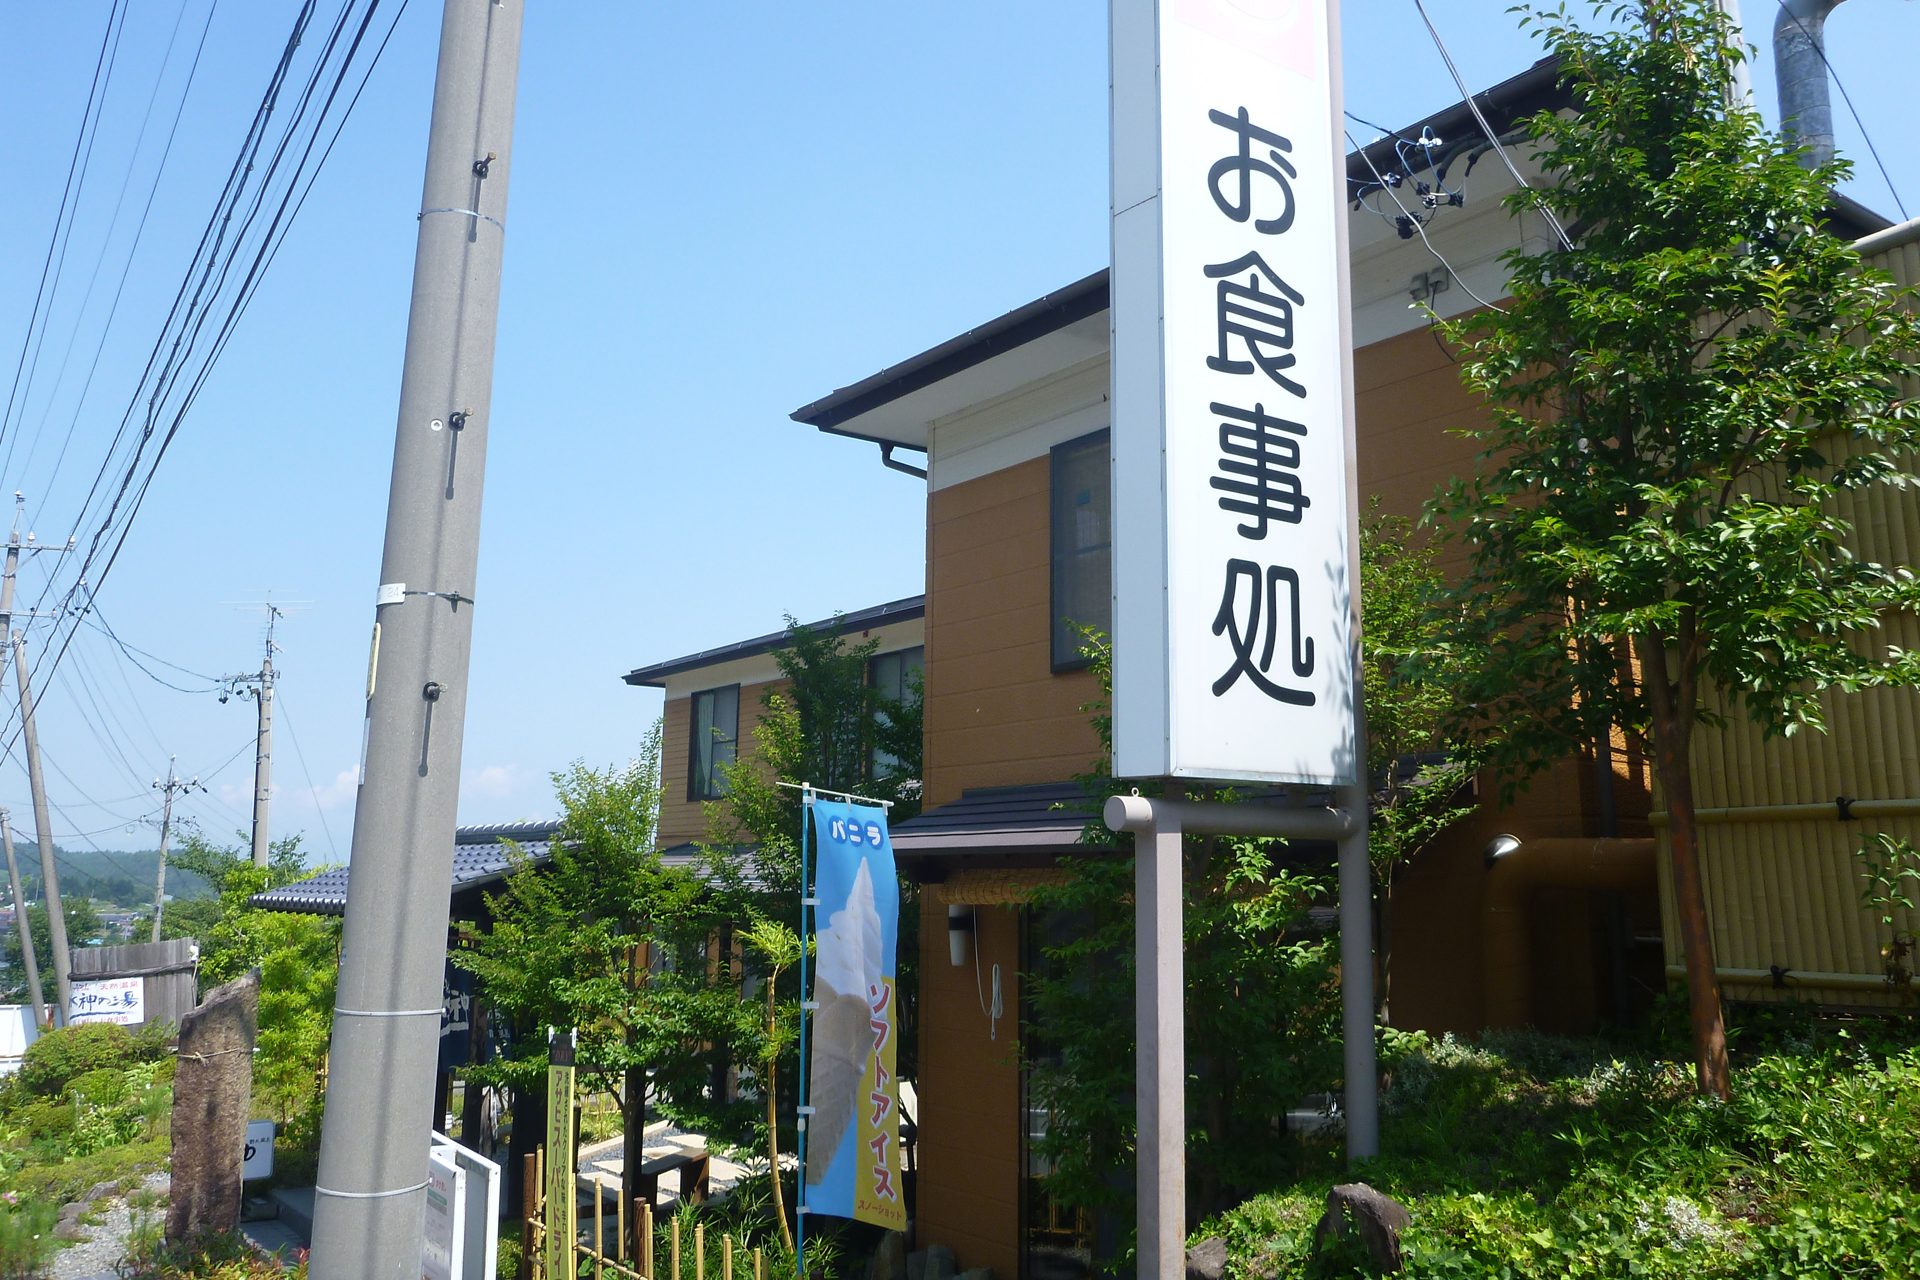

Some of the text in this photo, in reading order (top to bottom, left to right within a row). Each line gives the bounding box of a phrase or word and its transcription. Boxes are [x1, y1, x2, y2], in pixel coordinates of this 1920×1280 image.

[1203, 106, 1316, 707] お食事処
[832, 820, 881, 846] バニラ
[551, 1070, 563, 1276] アサヒスーパードライ
[870, 983, 896, 1202] ソフトアイス
[858, 1200, 901, 1221] スノーショット
